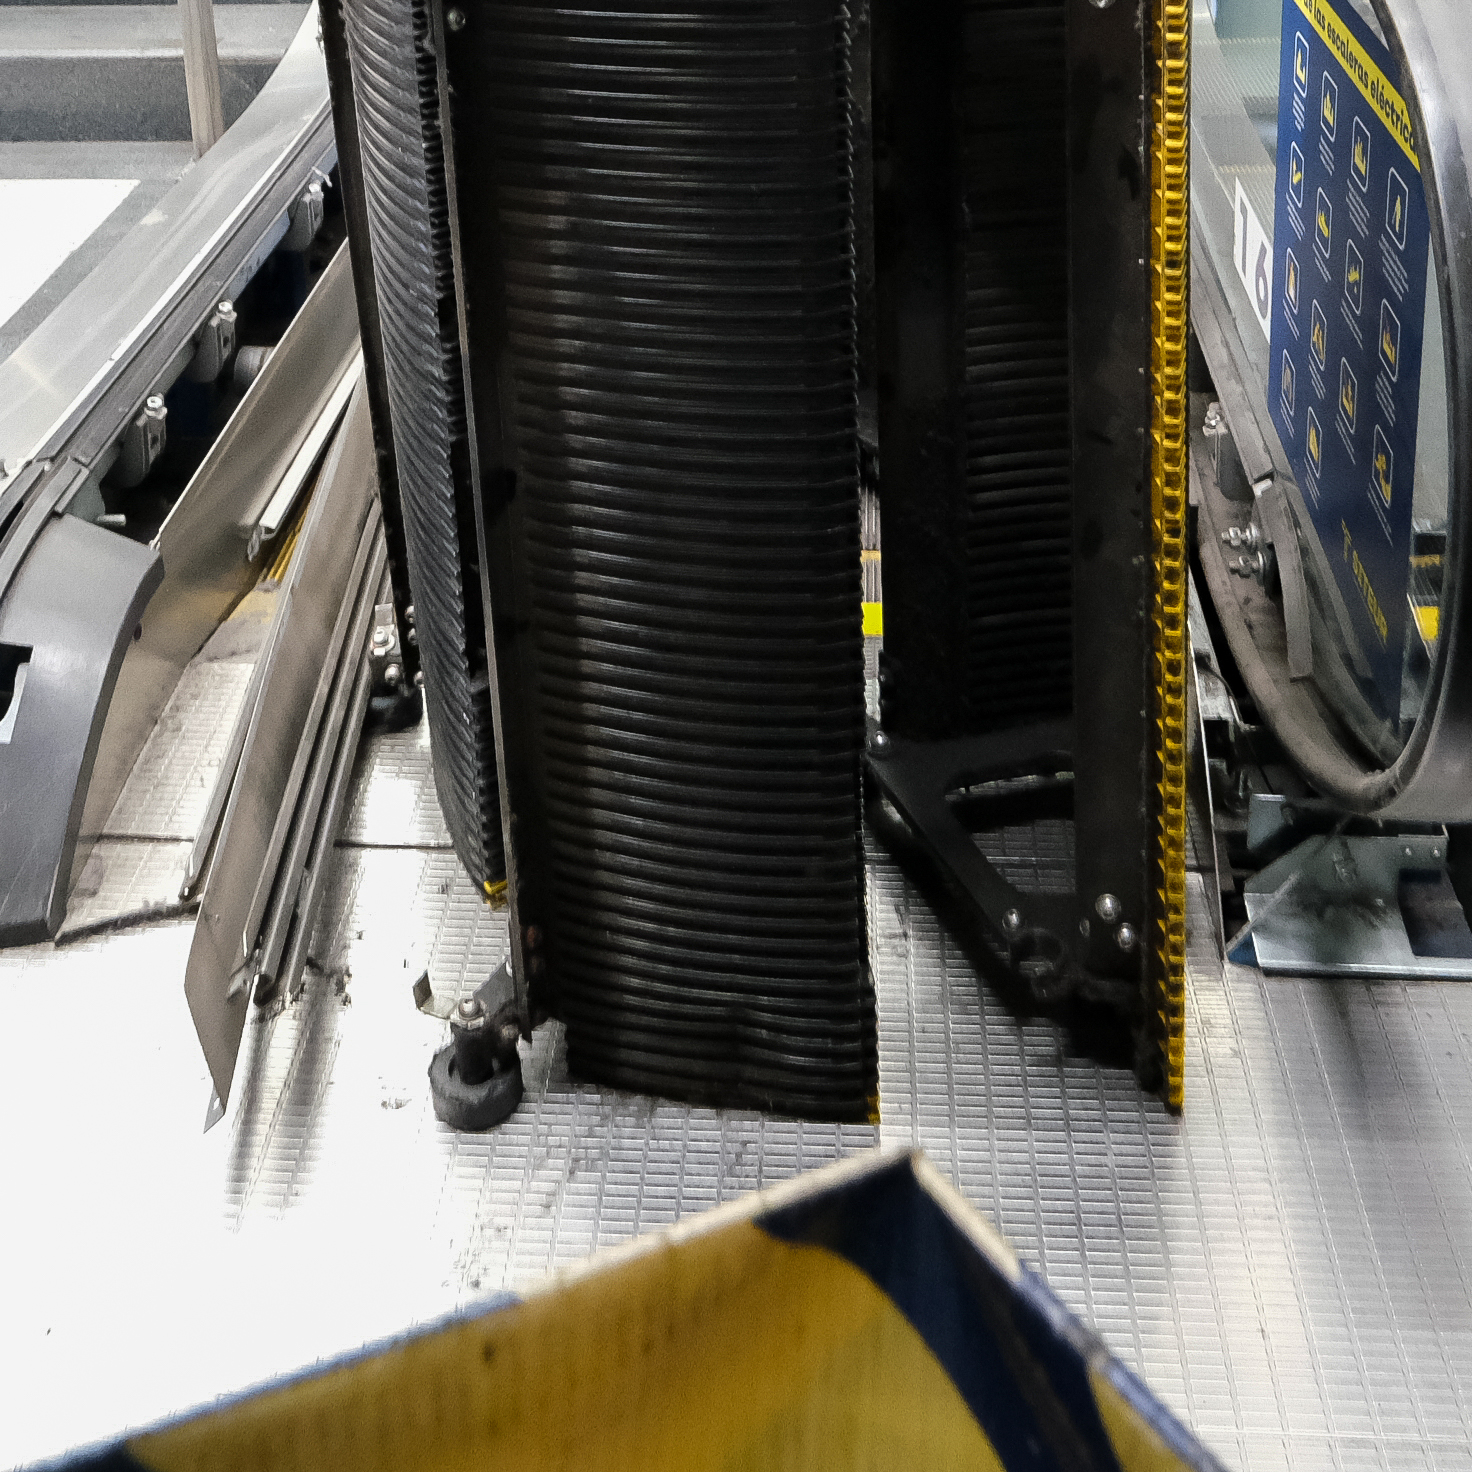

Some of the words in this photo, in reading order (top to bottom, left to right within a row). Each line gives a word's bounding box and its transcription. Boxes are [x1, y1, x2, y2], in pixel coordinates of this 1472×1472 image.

[1326, 22, 1369, 92] escaleras
[1370, 76, 1416, 156] eléctrica
[1239, 195, 1269, 321] 16
